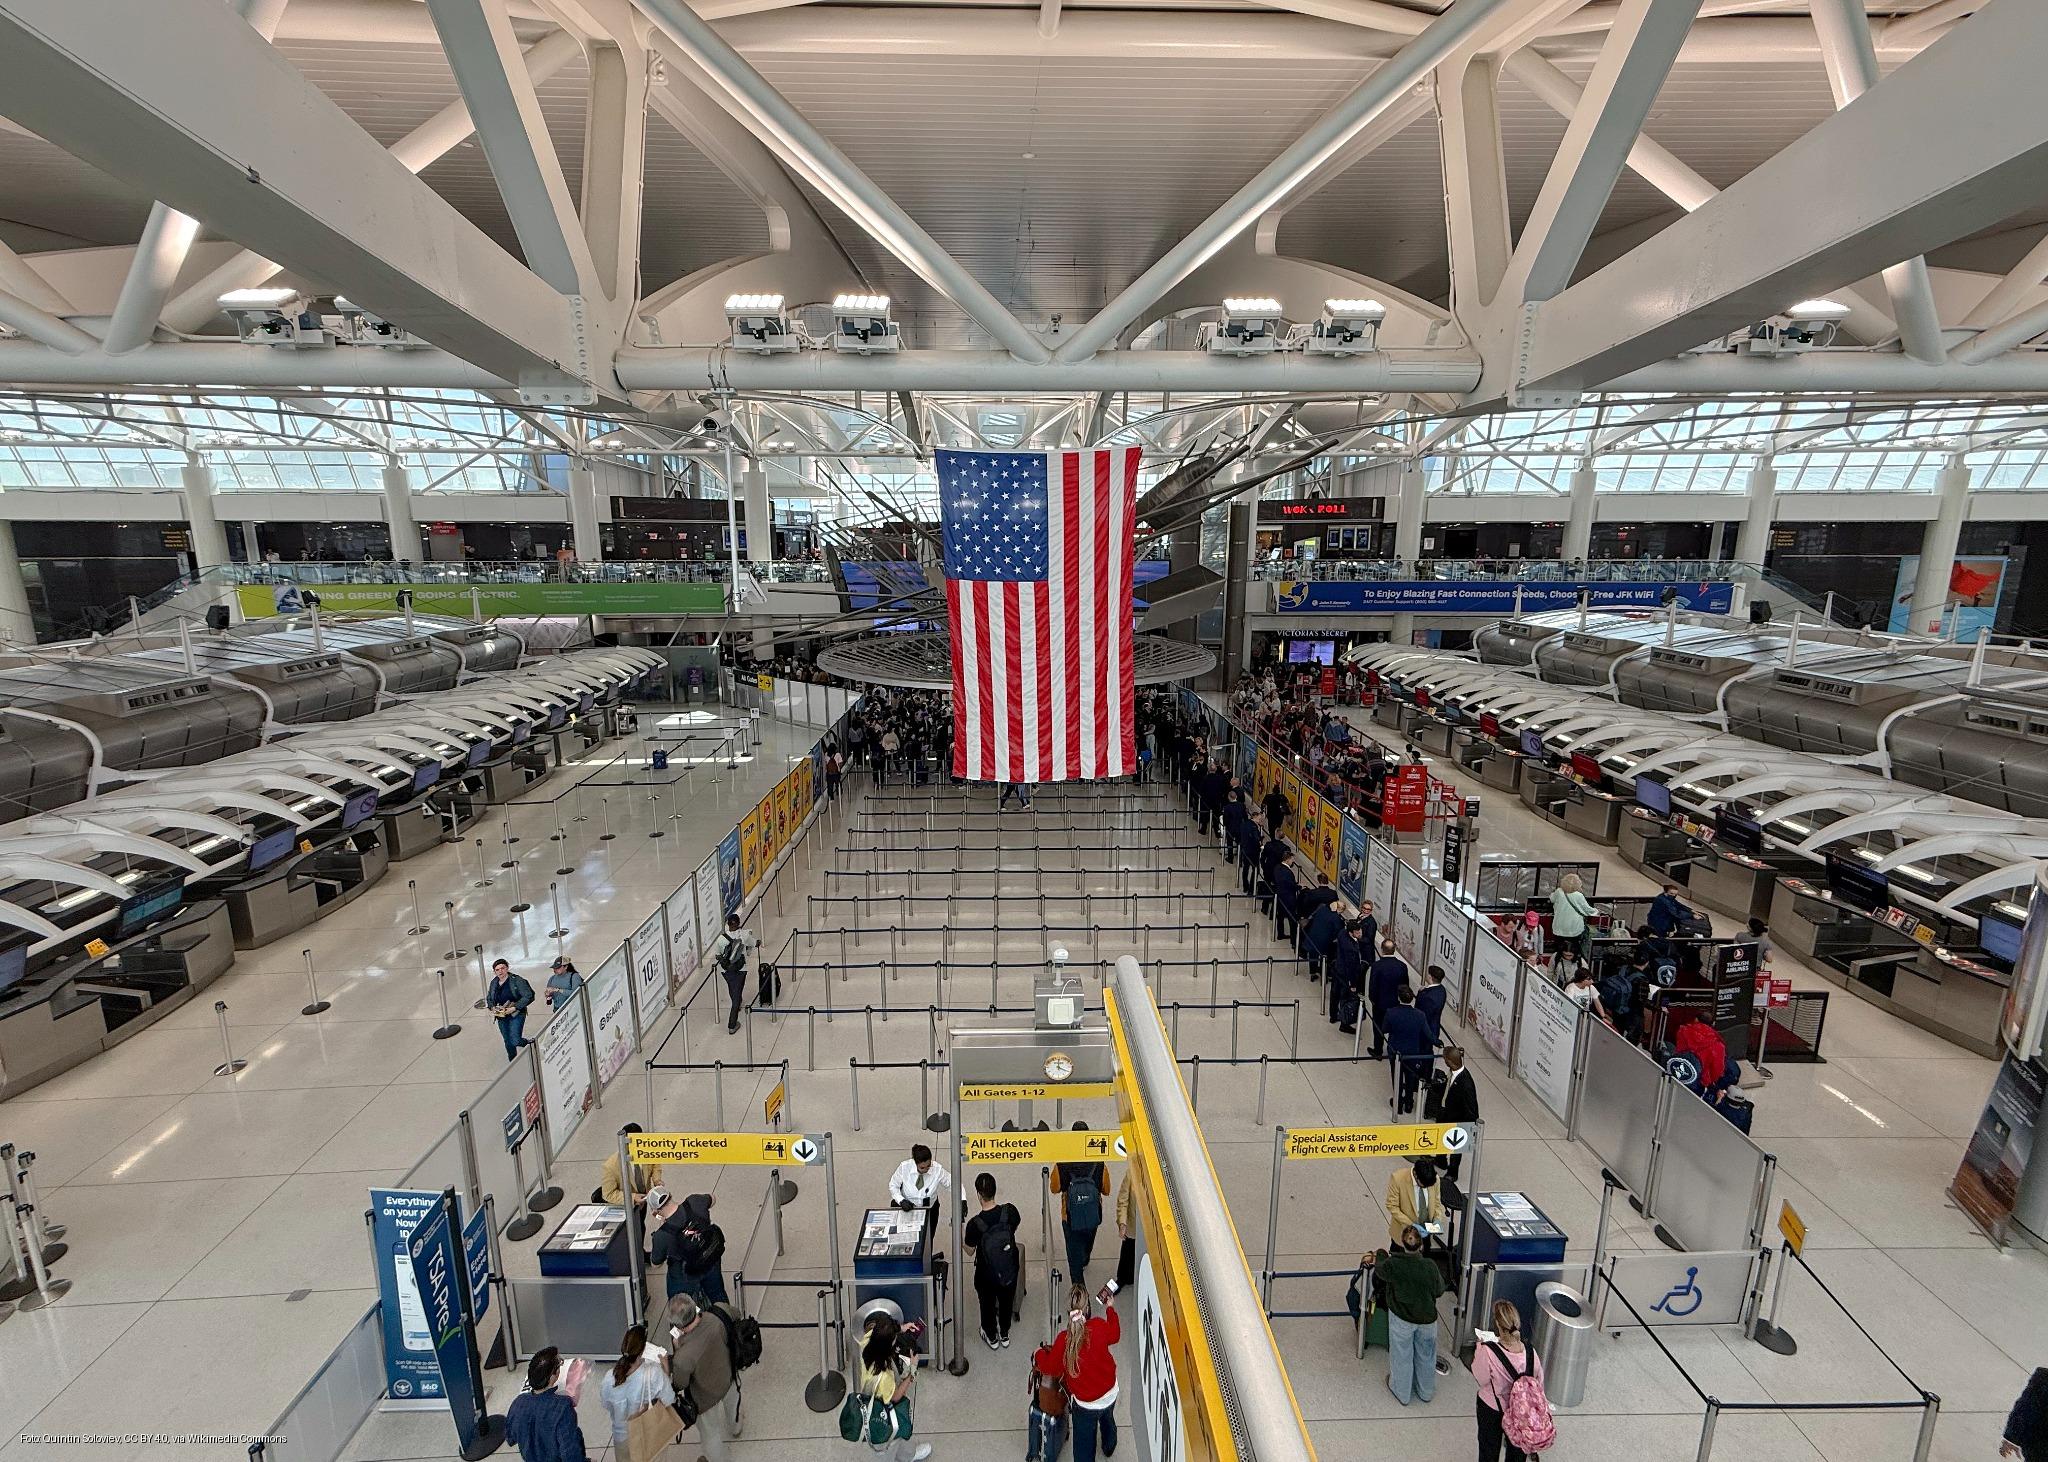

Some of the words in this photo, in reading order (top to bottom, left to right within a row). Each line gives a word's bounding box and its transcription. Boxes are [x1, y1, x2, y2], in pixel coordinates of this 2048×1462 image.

[416, 591, 456, 599] GOING
[459, 591, 520, 599] ELECTRIC.
[1364, 590, 1375, 598] To
[1377, 590, 1401, 600] Enjoy
[1403, 590, 1436, 600] Blazing
[1437, 590, 1458, 598] Fast
[1459, 590, 1510, 598] Connection
[1549, 590, 1578, 599] Choos
[1616, 590, 1633, 599] JFK
[1635, 590, 1655, 599] WiFi
[1406, 907, 1421, 925] BEAUTY
[1726, 960, 1750, 968] TURKISH
[1487, 981, 1506, 1004] BEAUTY
[1547, 989, 1564, 1007] BEAUTY
[606, 998, 624, 1023] BEAUTY
[964, 1089, 981, 1097] All
[984, 1089, 1017, 1097] Gates
[635, 1138, 677, 1149] Priority
[679, 1138, 728, 1148] Ticketed
[970, 1139, 986, 1148] All
[987, 1138, 1037, 1148] Ticketed
[1292, 1134, 1326, 1144] Special
[1328, 1133, 1378, 1143] Assistance
[1291, 1145, 1319, 1156] Flight
[1321, 1144, 1346, 1153] Crew
[1348, 1144, 1356, 1153] &
[1358, 1143, 1409, 1154] Employees
[636, 1150, 699, 1160] Passengers
[971, 1150, 1034, 1161] Passengers
[383, 1208, 395, 1216] on
[396, 1209, 418, 1218] your
[395, 1218, 417, 1228] Now
[400, 1230, 410, 1238] ID
[470, 1245, 487, 1271] Enter
